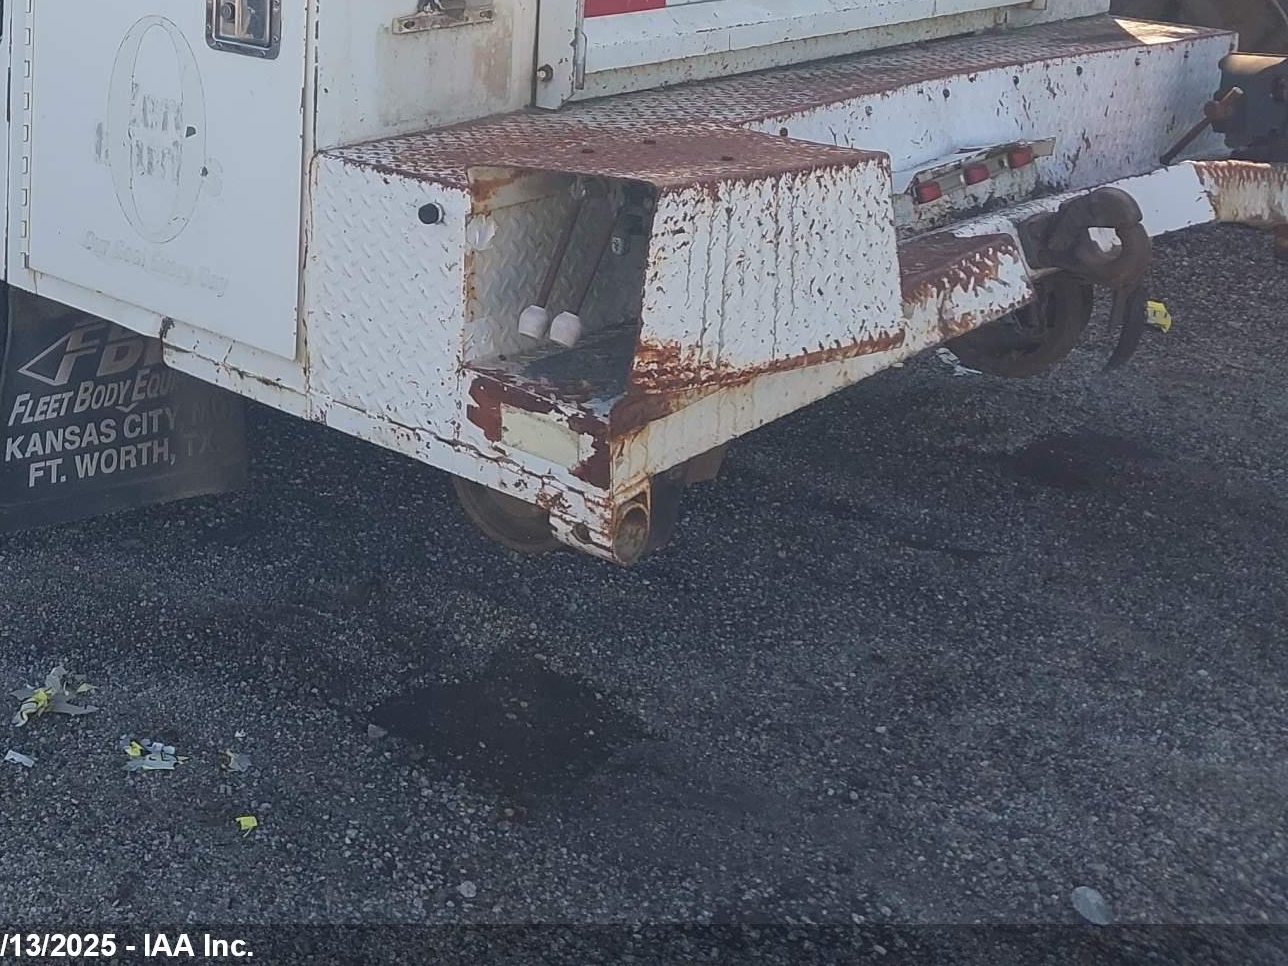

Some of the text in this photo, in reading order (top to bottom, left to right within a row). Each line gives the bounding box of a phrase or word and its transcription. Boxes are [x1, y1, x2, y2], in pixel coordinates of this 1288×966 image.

[8, 389, 74, 426] FLEET
[73, 379, 132, 413] BODY
[4, 418, 117, 462] KANSAS
[28, 458, 66, 488] FT.
[75, 437, 176, 479] WORTH,
